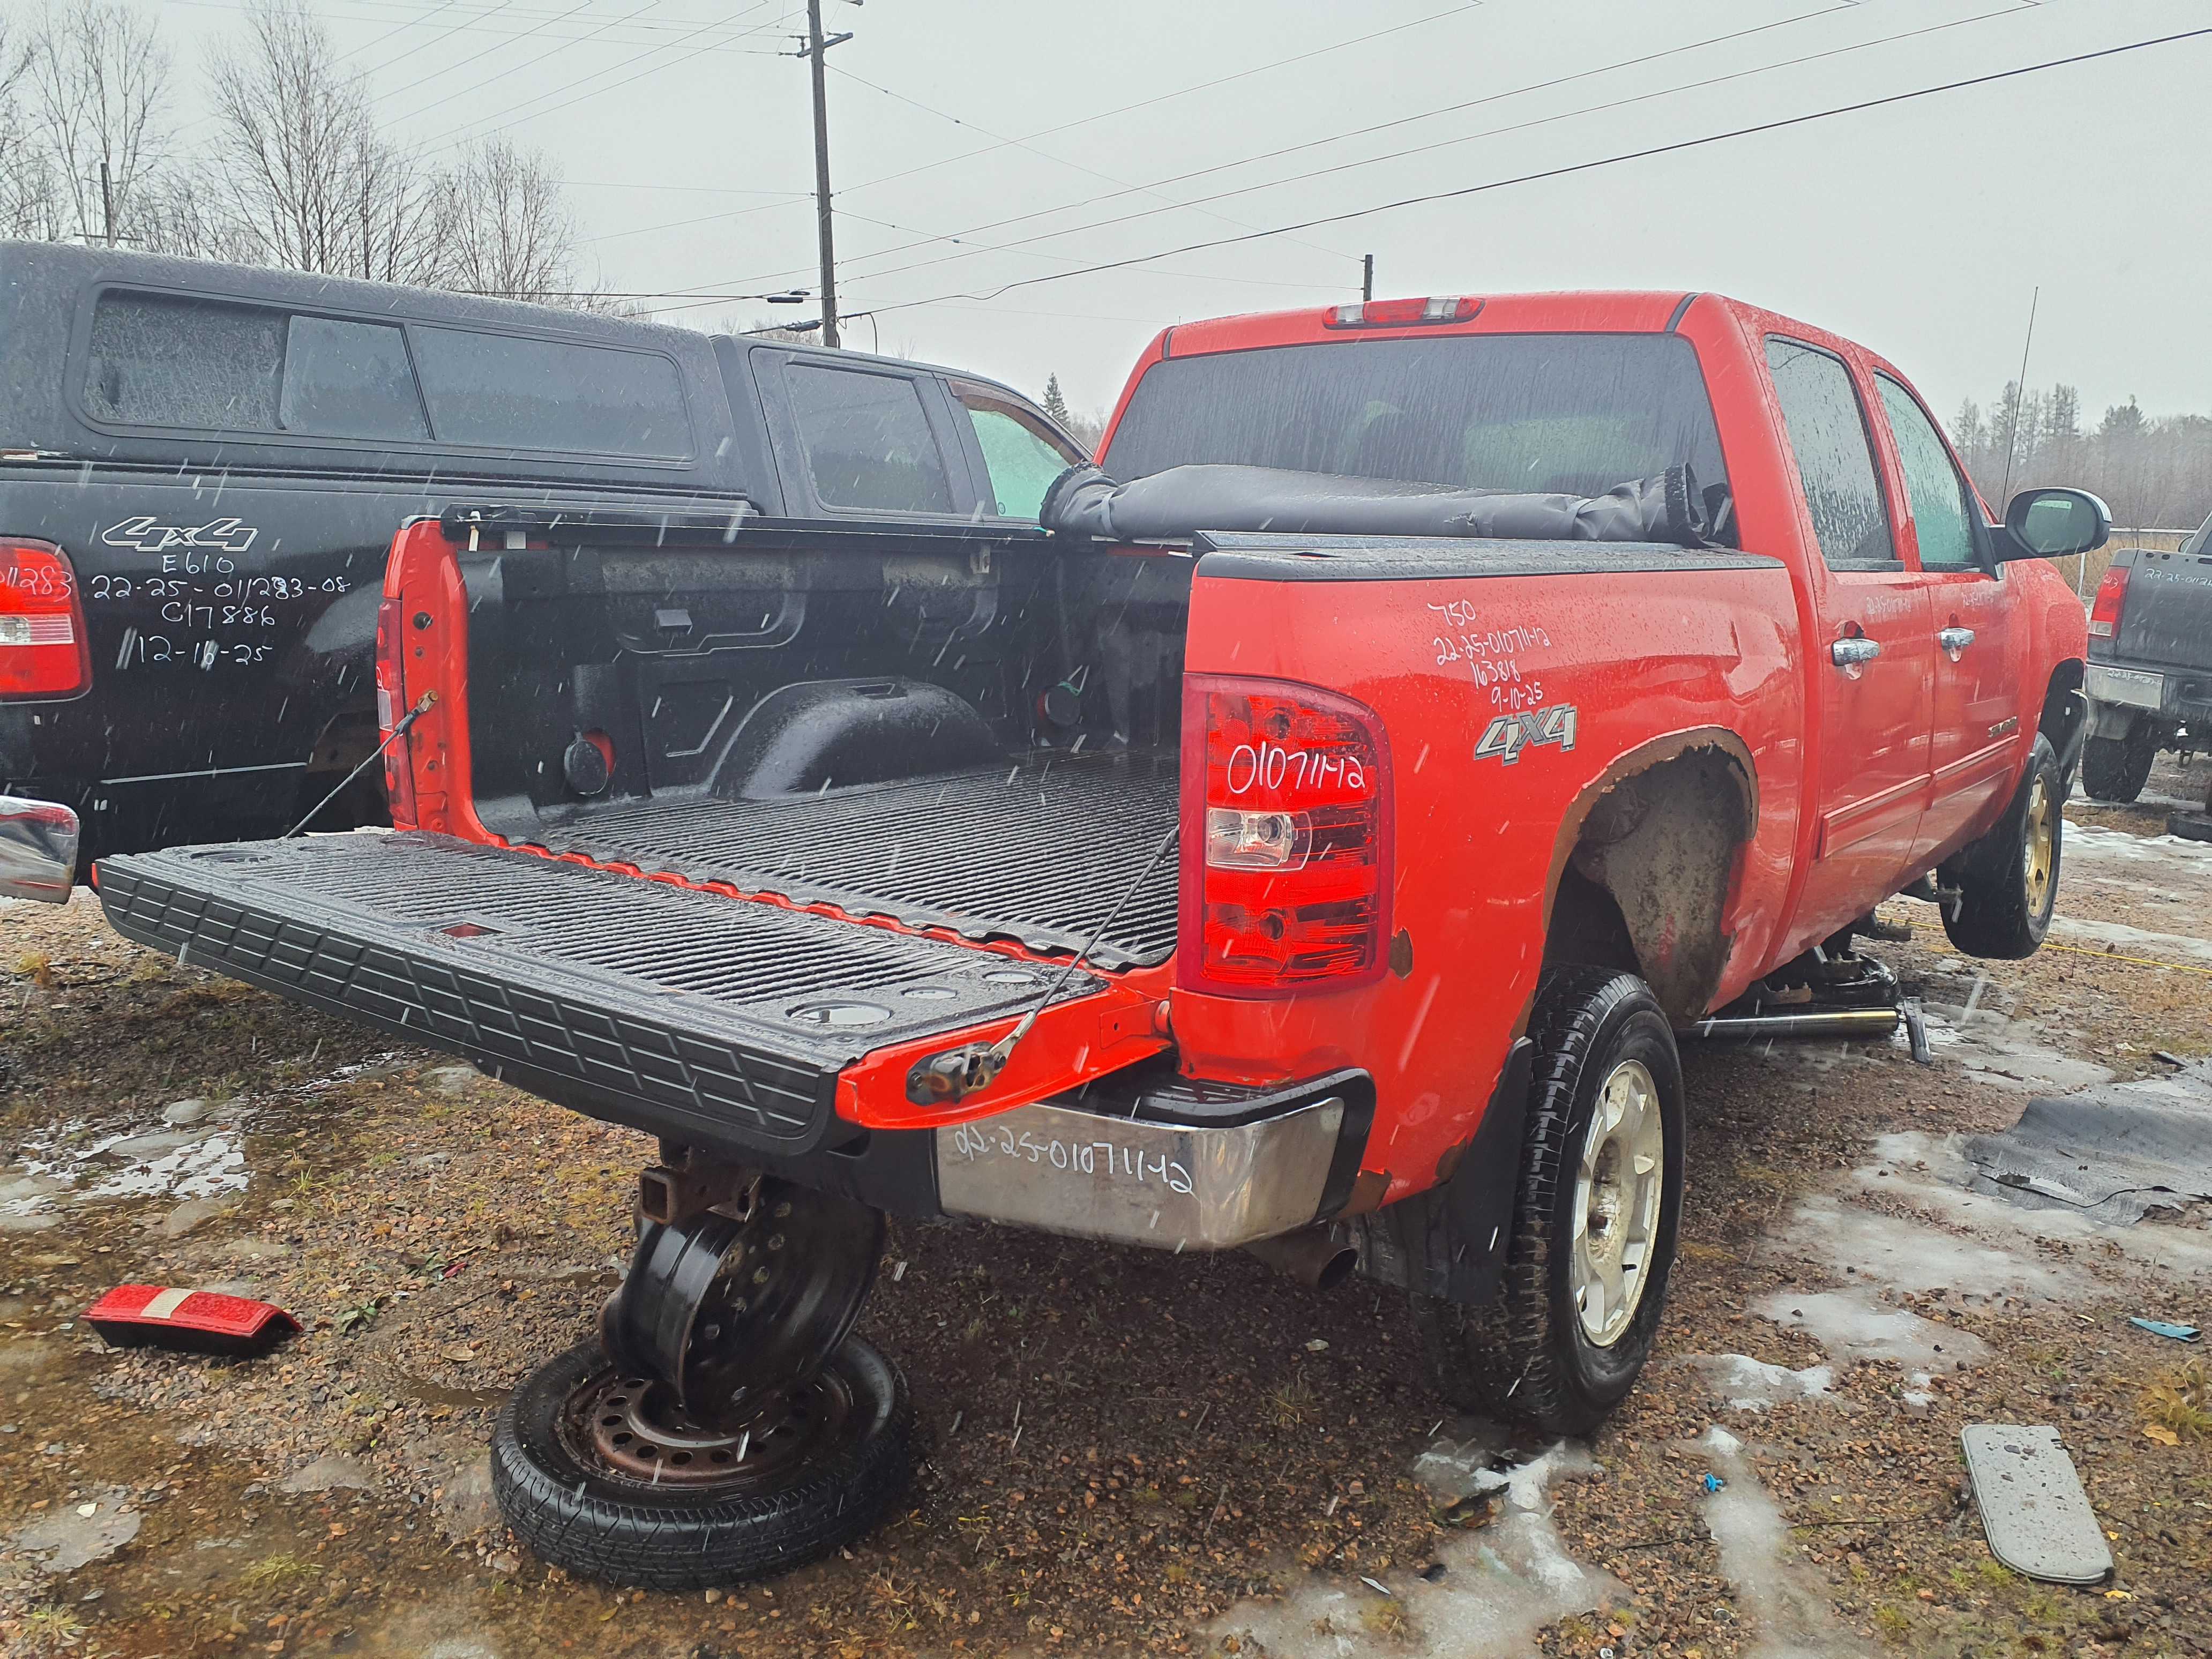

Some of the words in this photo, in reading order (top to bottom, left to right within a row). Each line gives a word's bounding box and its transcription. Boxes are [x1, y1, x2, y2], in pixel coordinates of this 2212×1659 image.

[1427, 599, 1476, 626] 750
[1470, 659, 1521, 689] 163818
[1491, 682, 1543, 712] 9-10-25
